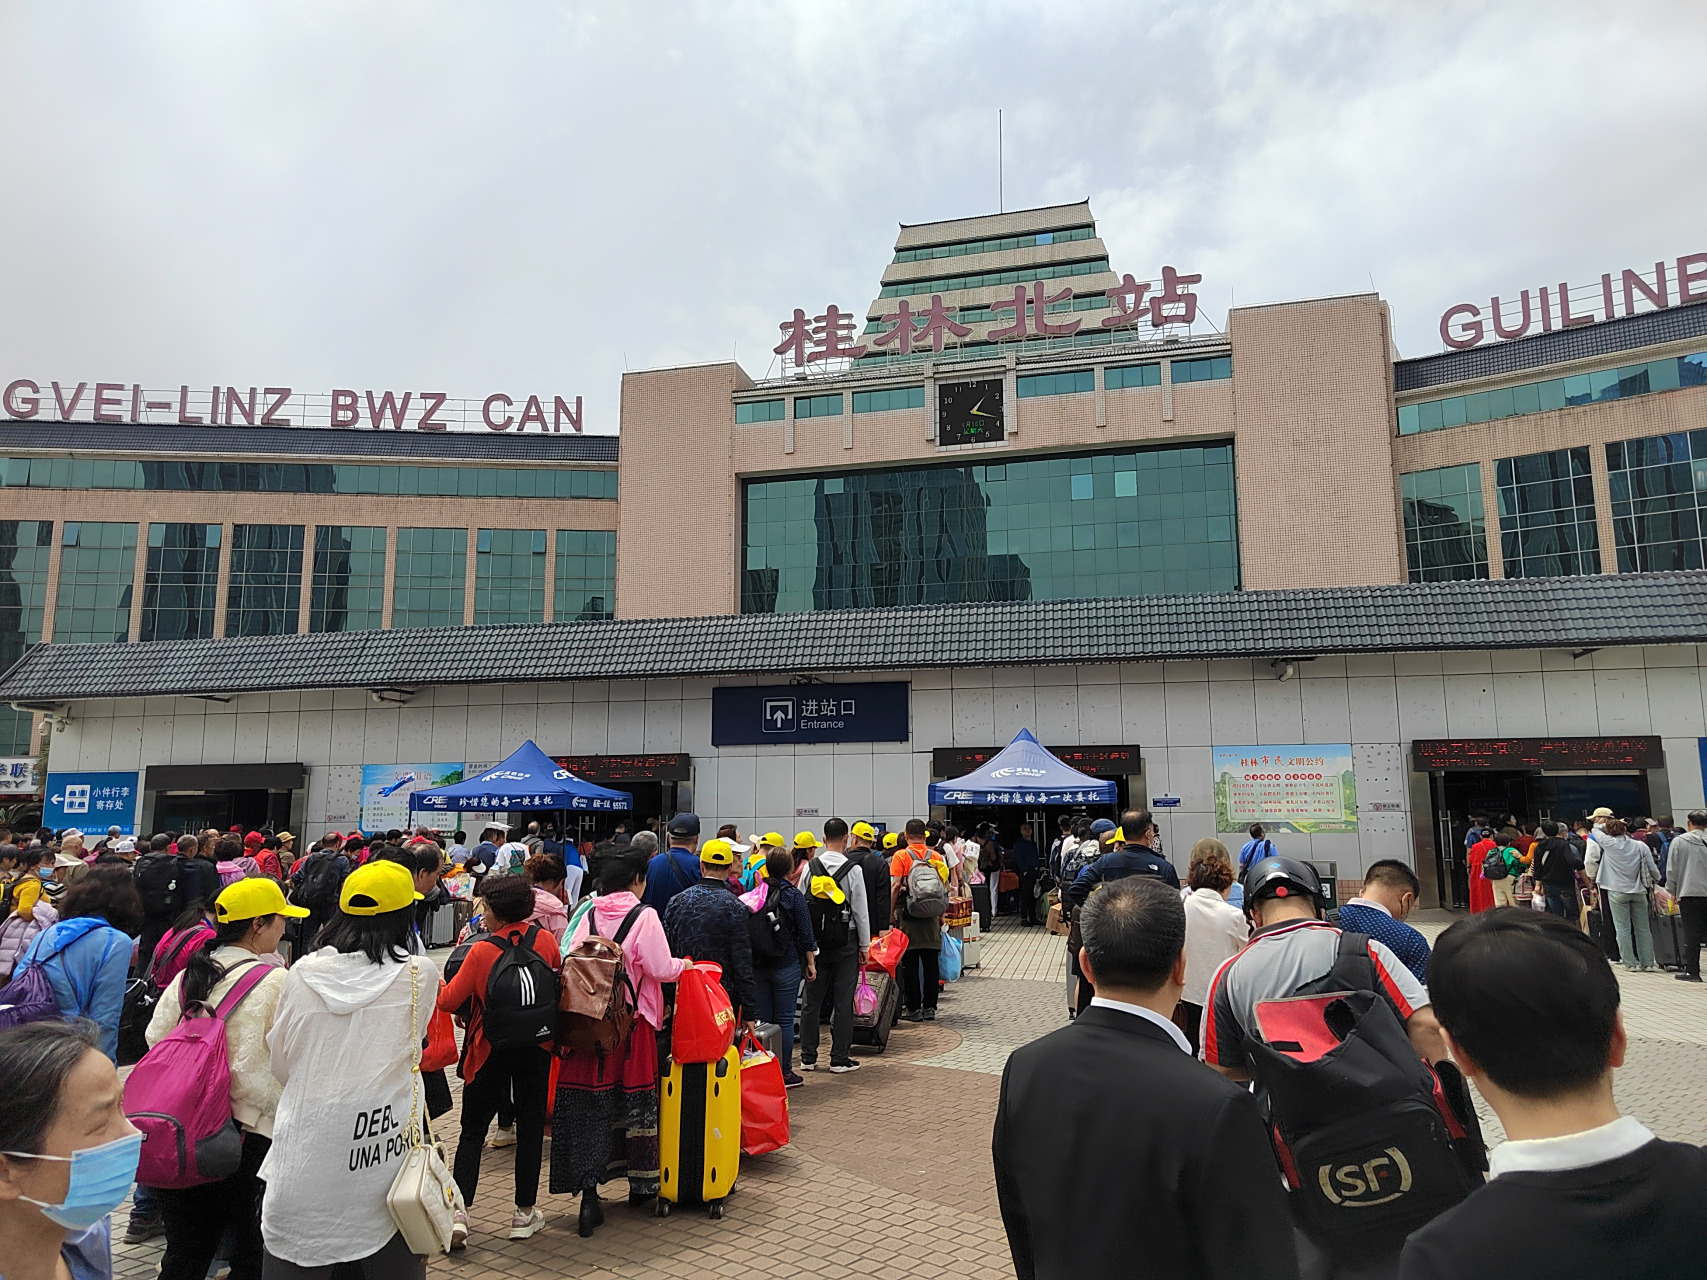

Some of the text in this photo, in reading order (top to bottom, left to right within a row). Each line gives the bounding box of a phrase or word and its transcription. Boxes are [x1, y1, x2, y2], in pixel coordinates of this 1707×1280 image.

[1440, 252, 1707, 349] GUILINB
[773, 265, 1202, 367] 桂林北站
[2, 379, 584, 433] GVEI-LINZ BWZ CAN
[801, 698, 855, 717] 进站口
[800, 719, 845, 729] Entrance
[92, 787, 130, 798] 小件行李
[943, 791, 974, 800] CRE
[986, 791, 1100, 804] 珍惜您的每一次委托
[96, 800, 124, 810] 寄存处
[423, 796, 449, 804] CRE
[459, 795, 554, 808] 珍惜您的每一次委托
[349, 1143, 381, 1172] UNA
